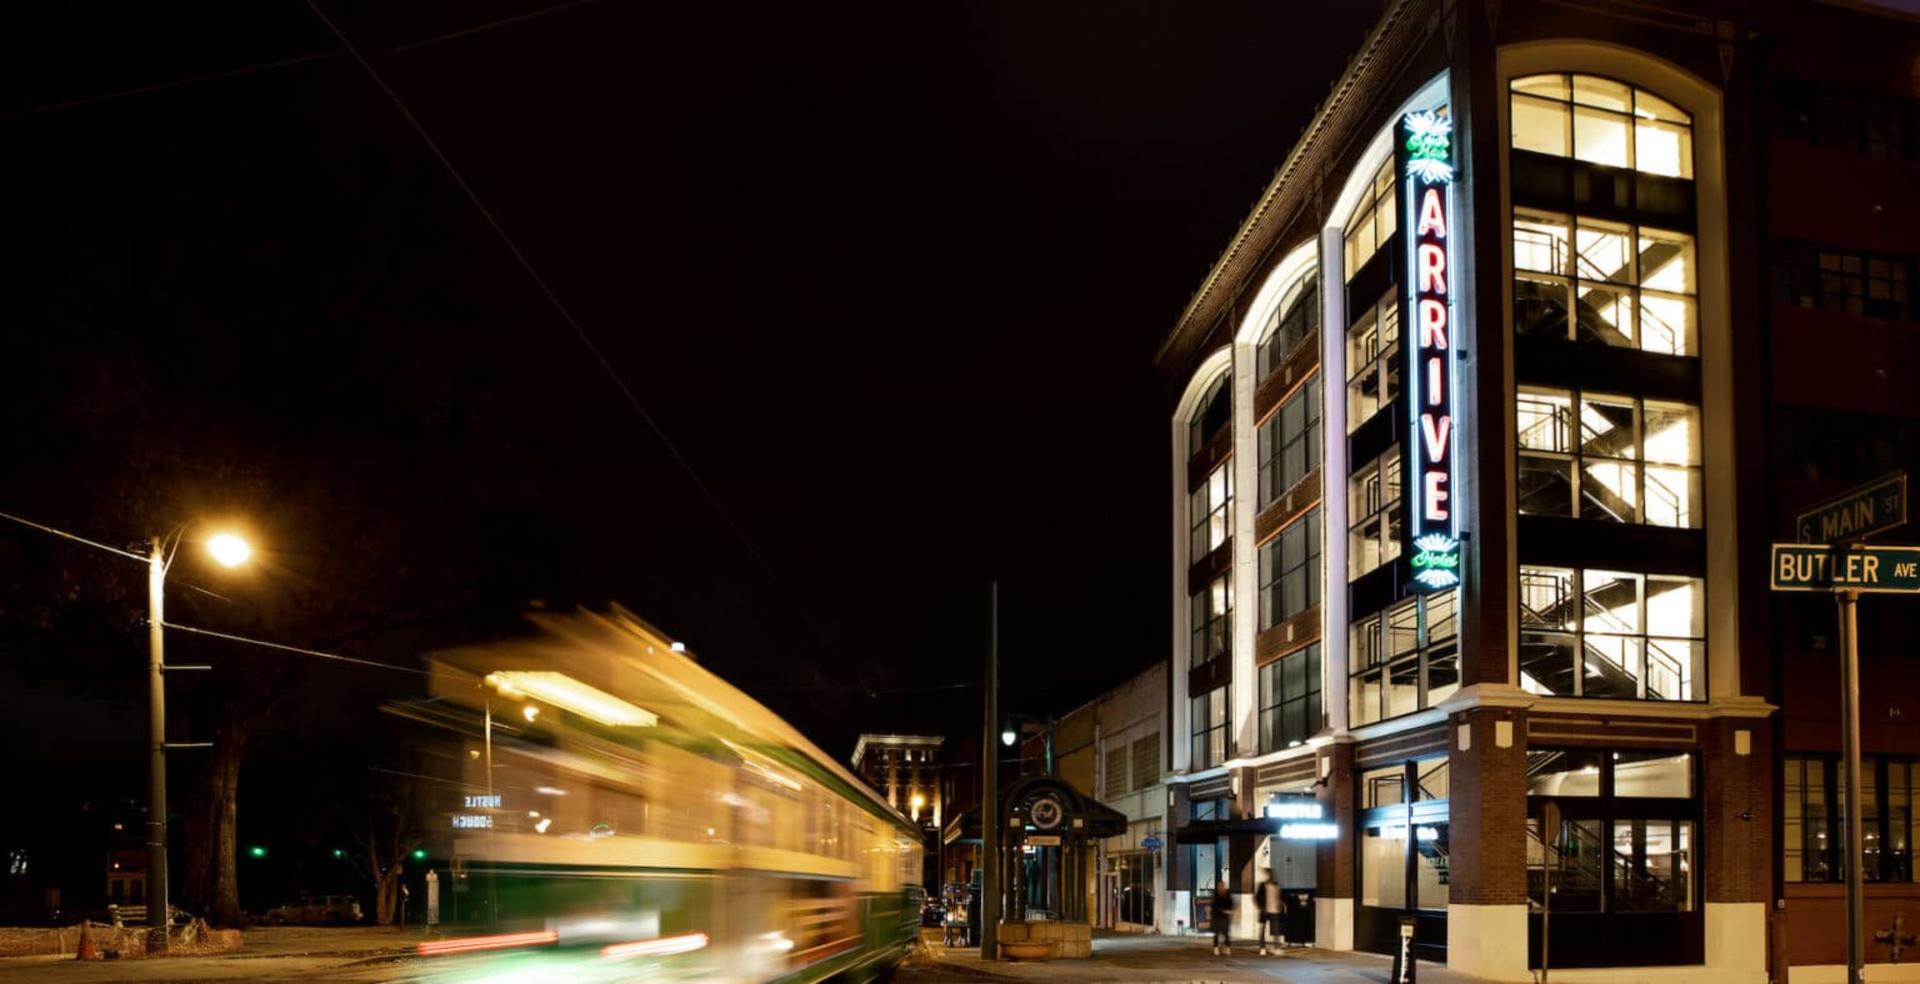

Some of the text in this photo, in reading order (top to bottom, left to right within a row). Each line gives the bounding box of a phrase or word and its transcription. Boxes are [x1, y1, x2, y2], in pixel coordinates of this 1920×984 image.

[1417, 187, 1449, 521] ARRIVE
[1801, 495, 1899, 544] S MAIN ST
[1411, 550, 1458, 568] Hotel
[1780, 553, 1917, 582] BUTLER AVE
